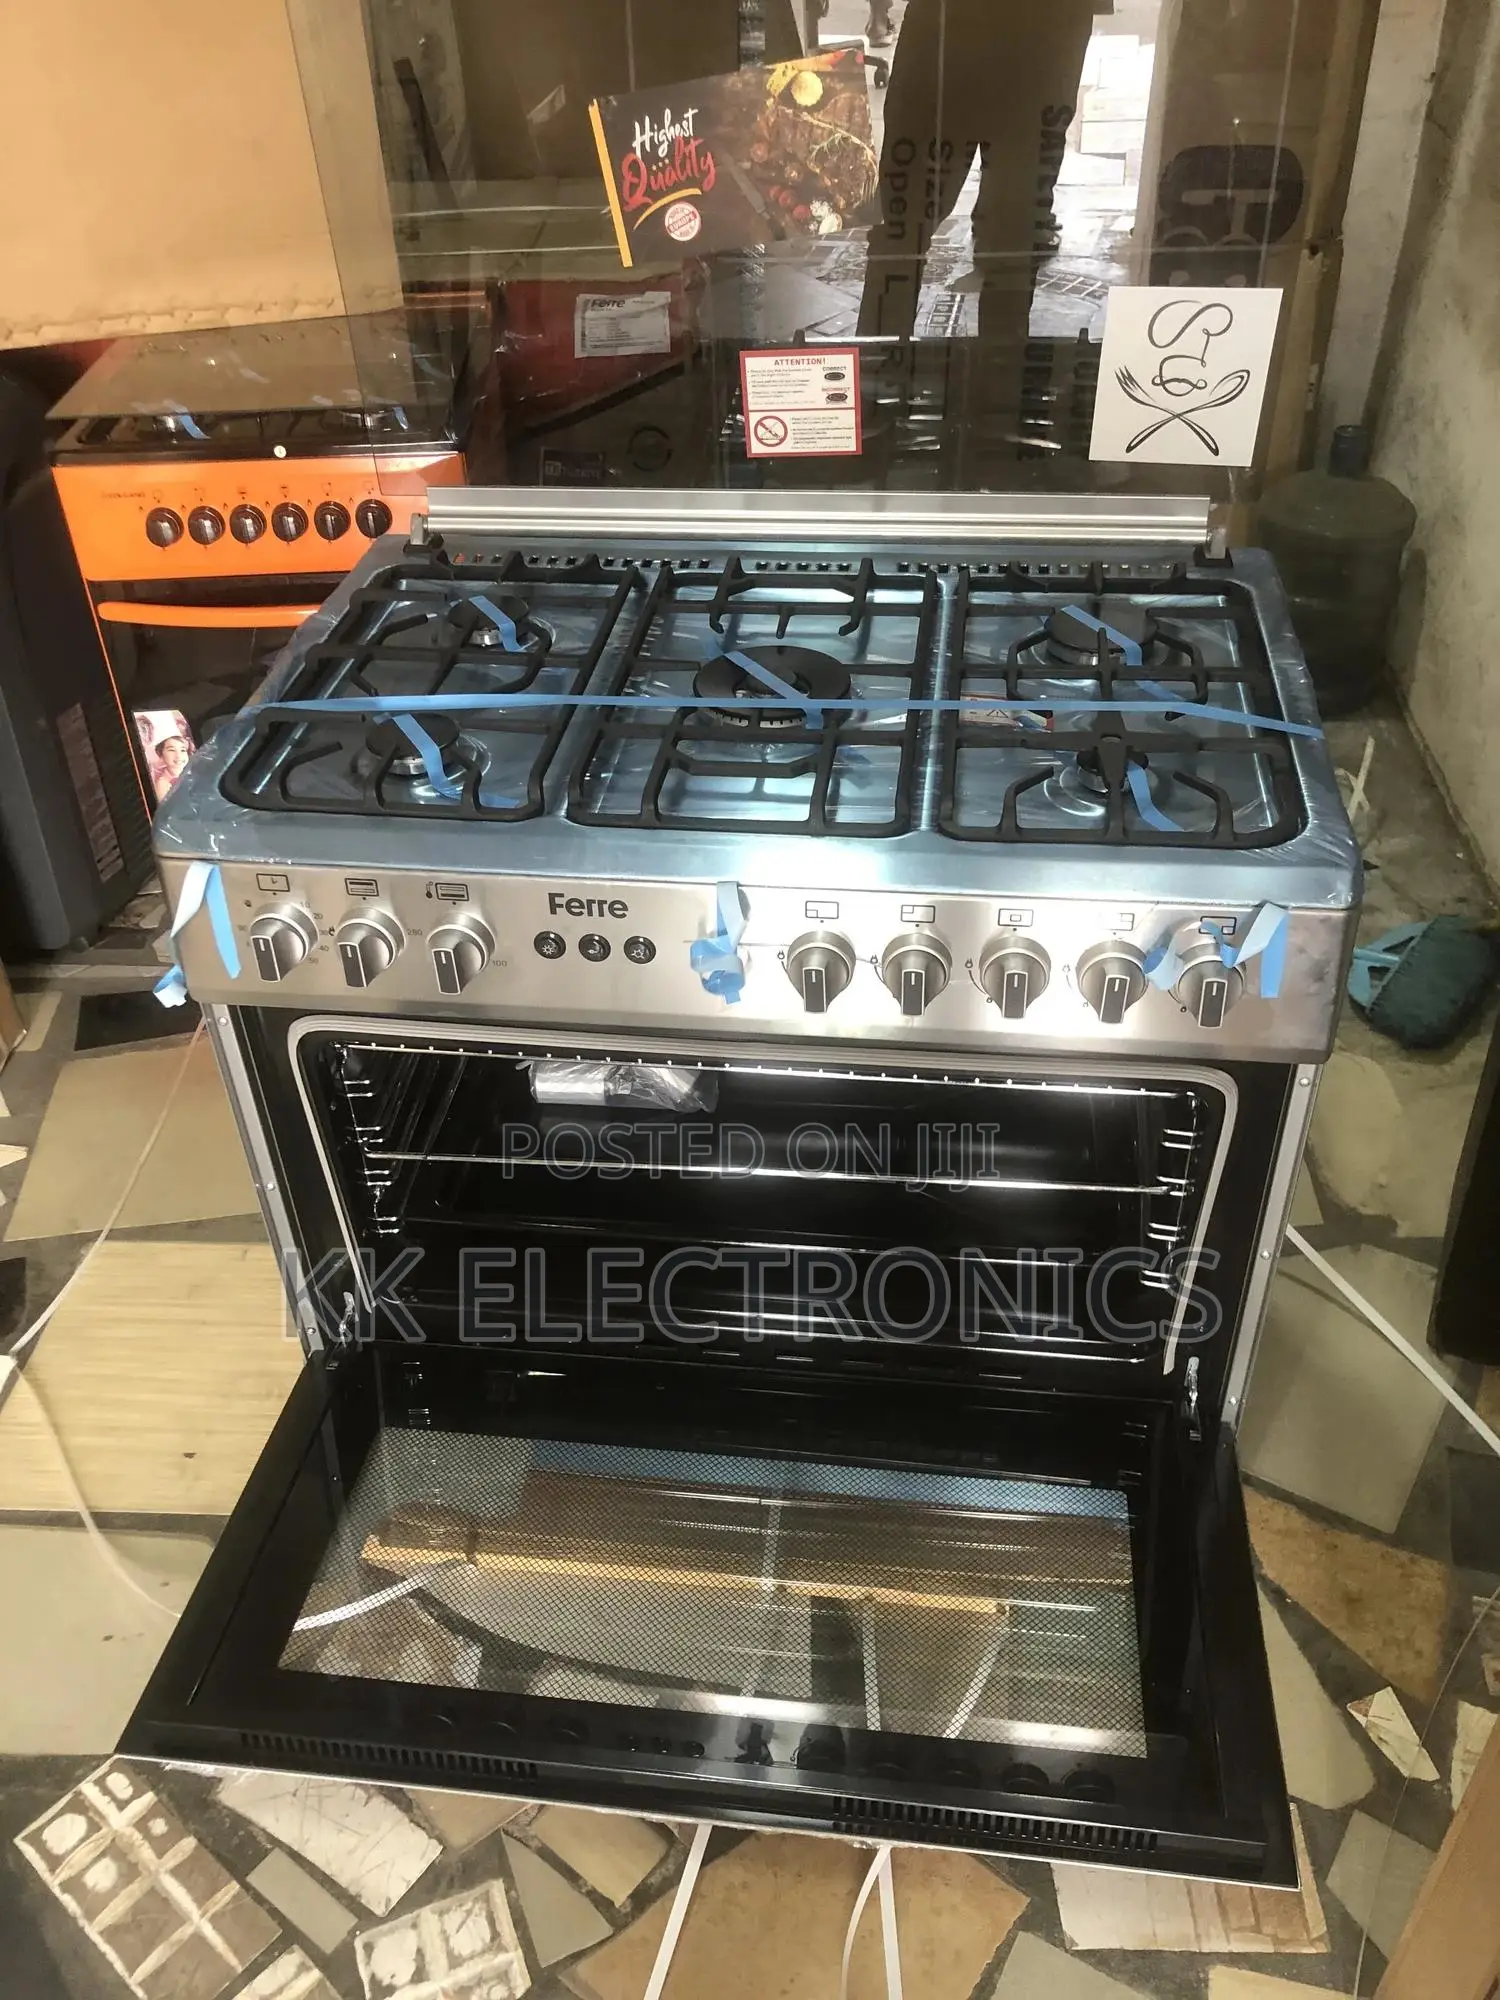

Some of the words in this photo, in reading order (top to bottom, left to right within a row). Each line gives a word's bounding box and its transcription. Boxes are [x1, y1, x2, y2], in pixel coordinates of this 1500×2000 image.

[632, 107, 699, 160] Highest
[621, 135, 716, 212] Quality
[886, 137, 916, 241] Open
[774, 357, 826, 366] ATTENTION!
[548, 892, 629, 919] Ferre
